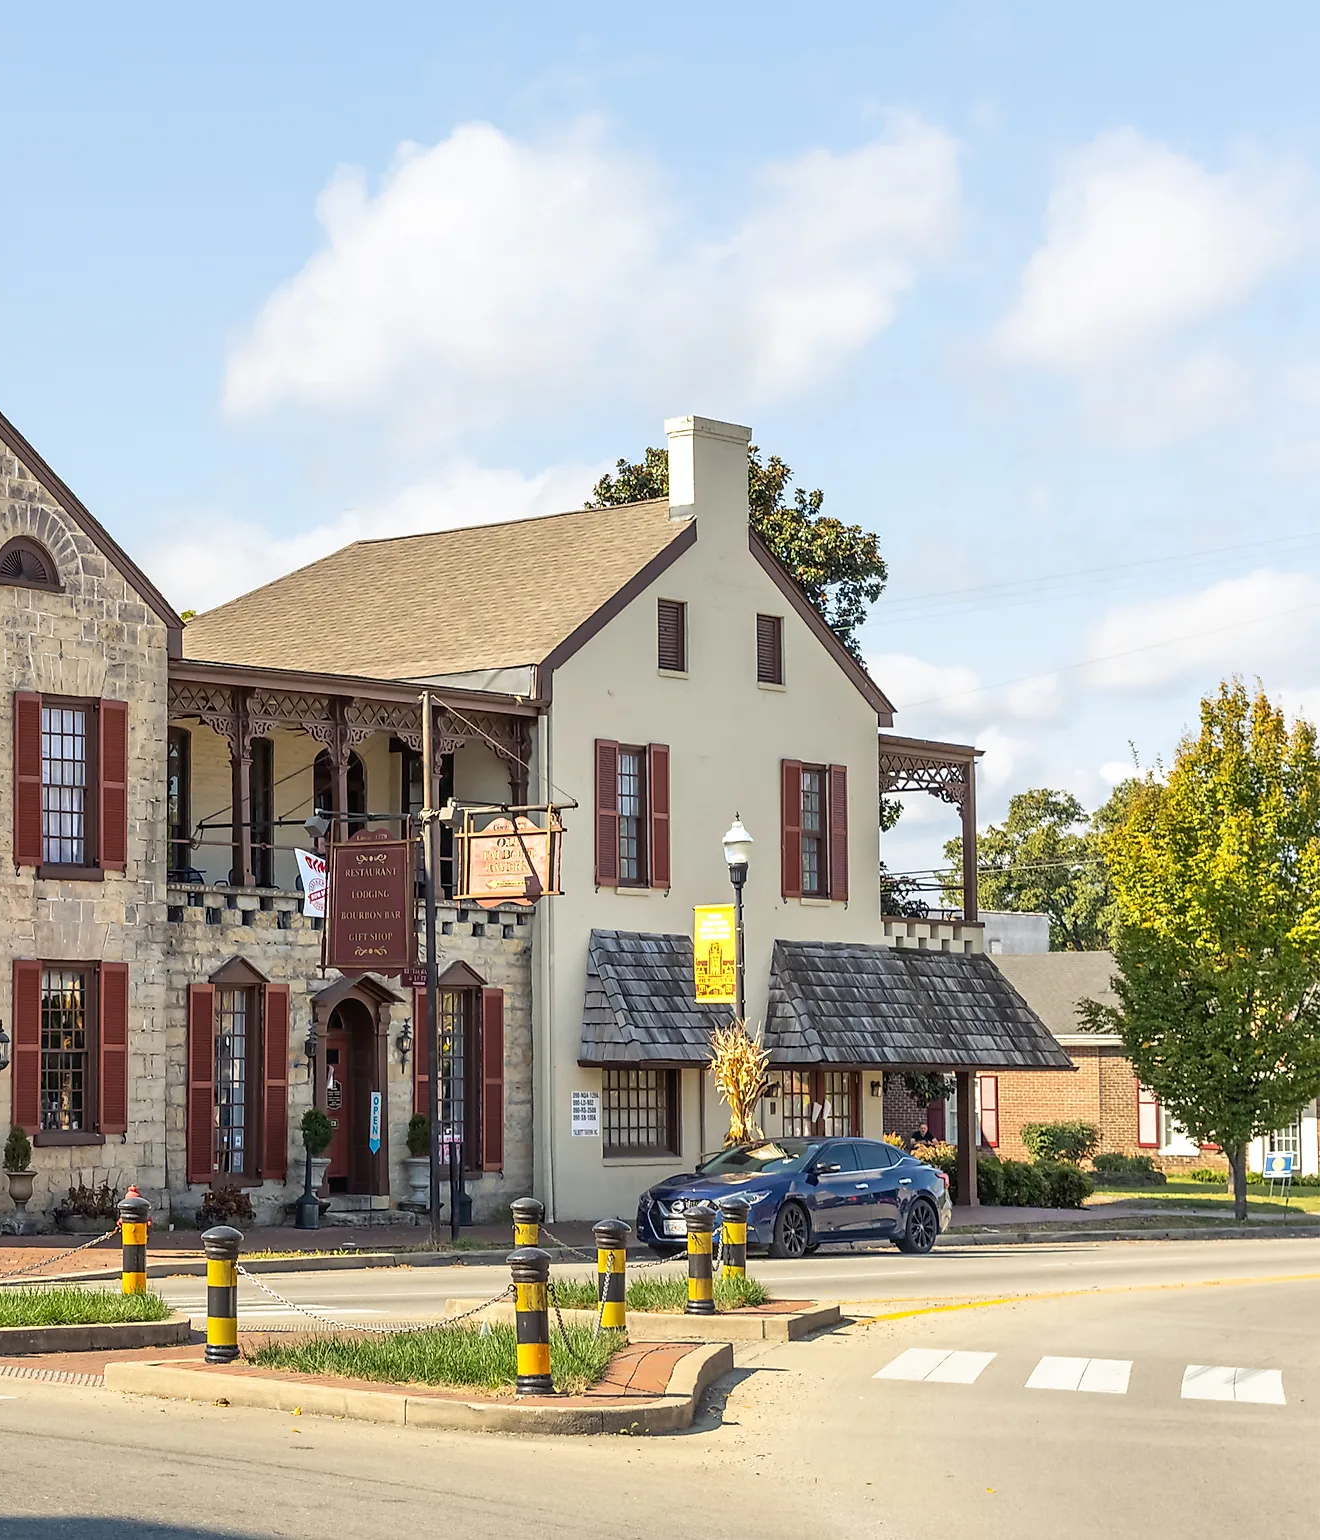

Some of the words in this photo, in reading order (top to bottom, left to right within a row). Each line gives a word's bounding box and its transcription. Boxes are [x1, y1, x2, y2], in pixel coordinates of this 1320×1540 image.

[345, 867, 398, 878] RESTAURANT
[351, 889, 390, 899] LODGING
[341, 911, 382, 920] BOURBON
[384, 910, 401, 919] BAR
[348, 933, 368, 942] GIFT
[370, 932, 393, 941] SHOP
[372, 1097, 380, 1135] OPEN
